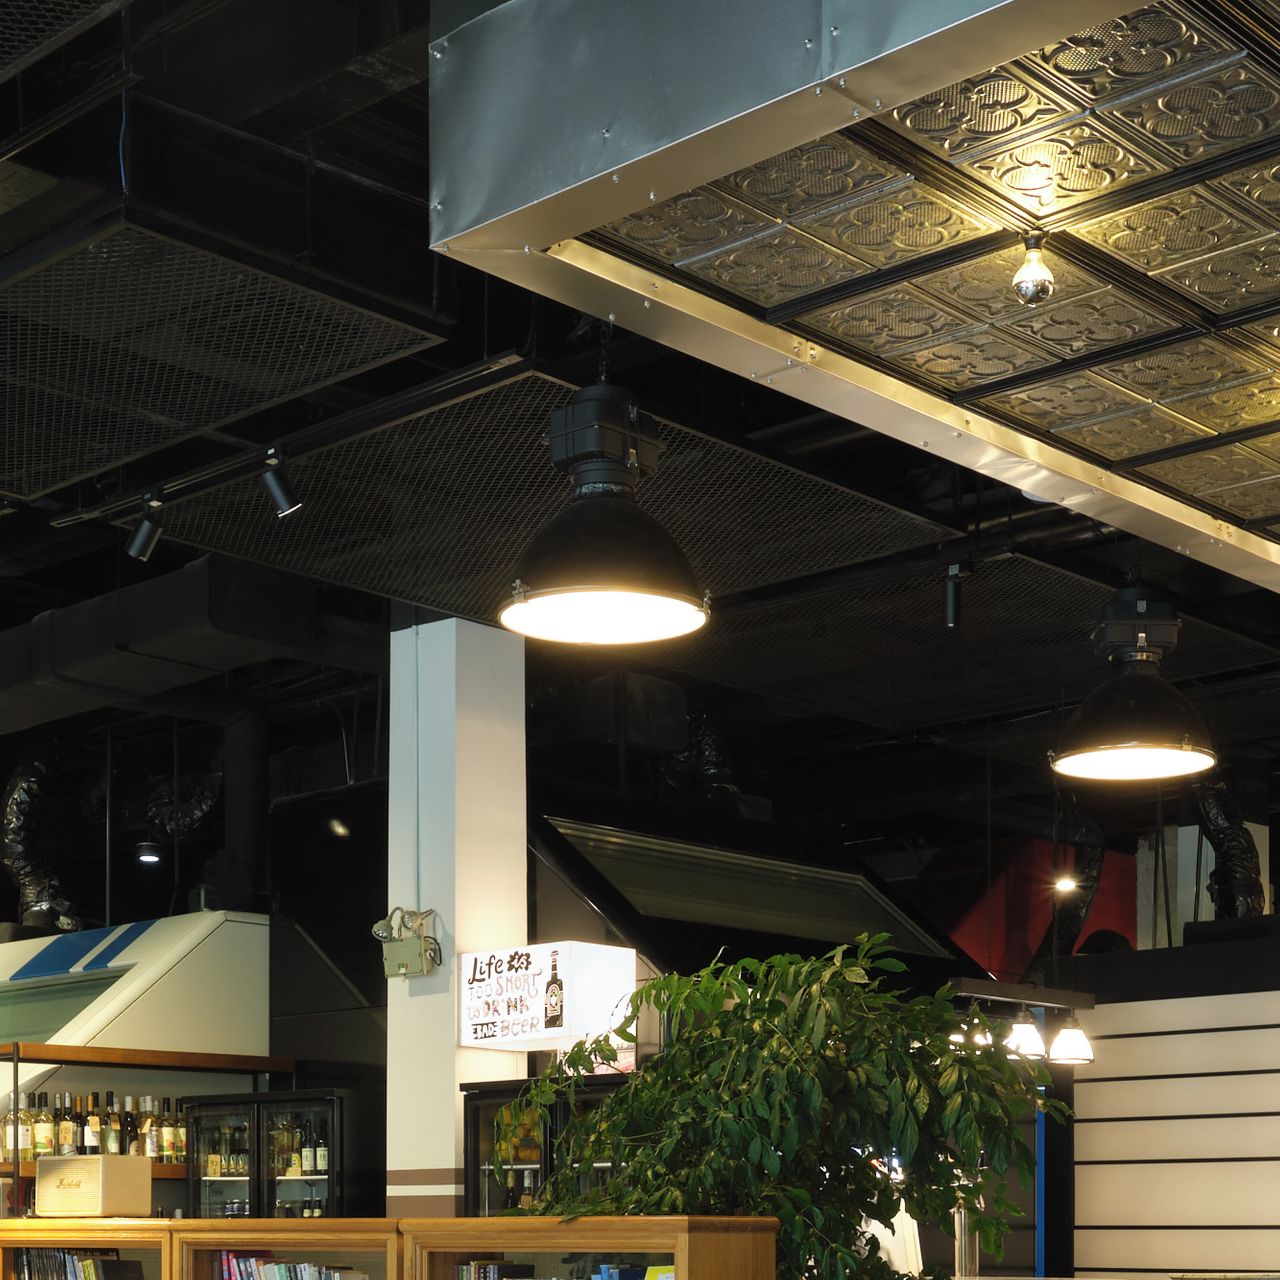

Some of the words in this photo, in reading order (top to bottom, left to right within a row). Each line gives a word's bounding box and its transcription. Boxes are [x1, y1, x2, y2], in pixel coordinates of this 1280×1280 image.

[467, 954, 504, 985] Life
[467, 984, 493, 1001] TOO
[495, 967, 542, 998] SHORT
